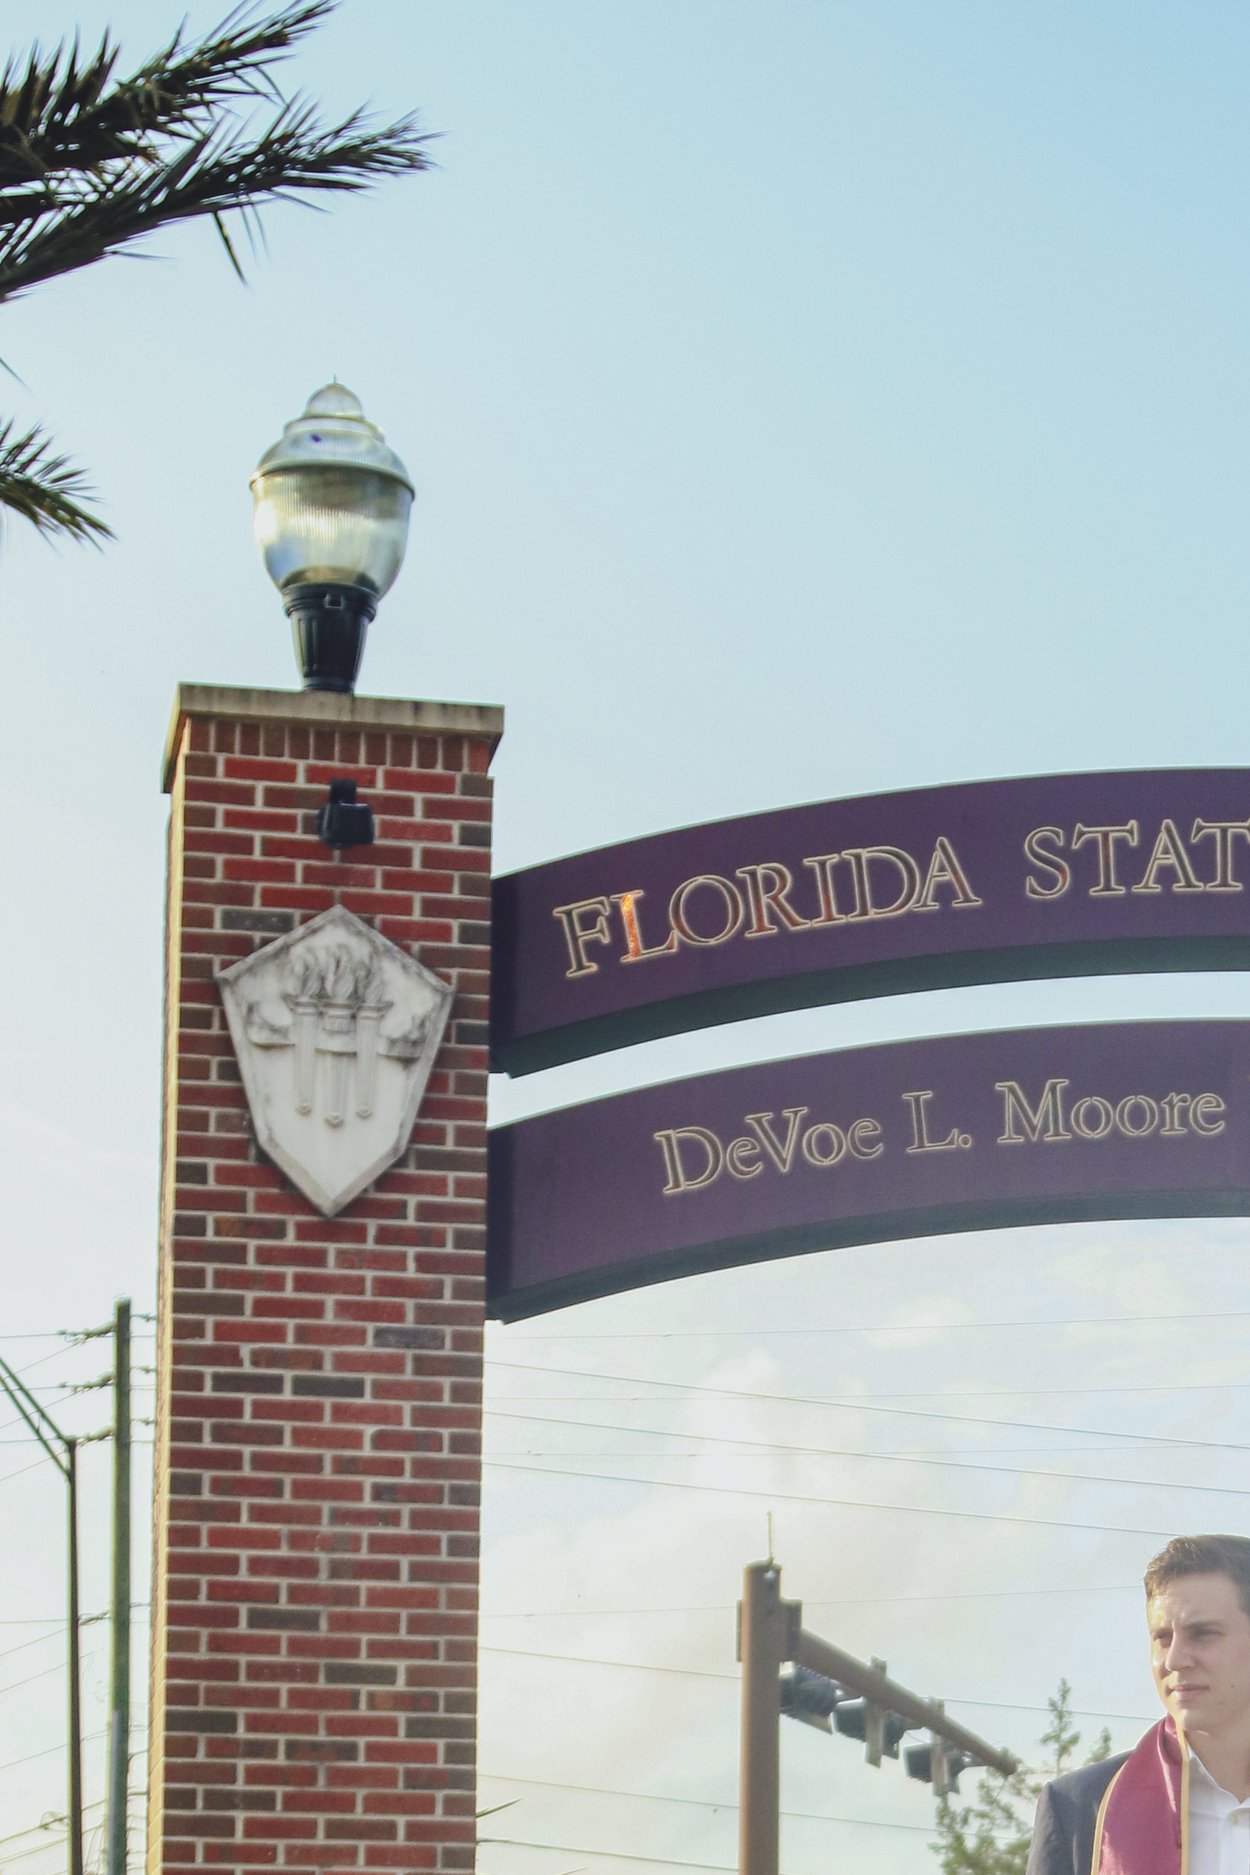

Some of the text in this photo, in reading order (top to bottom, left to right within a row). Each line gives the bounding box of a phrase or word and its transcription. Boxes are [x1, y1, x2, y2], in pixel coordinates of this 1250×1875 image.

[553, 836, 983, 979] FLORIDA
[653, 1106, 883, 1196] DeVoe
[902, 1089, 974, 1155] L.
[994, 1078, 1227, 1145] Moore
